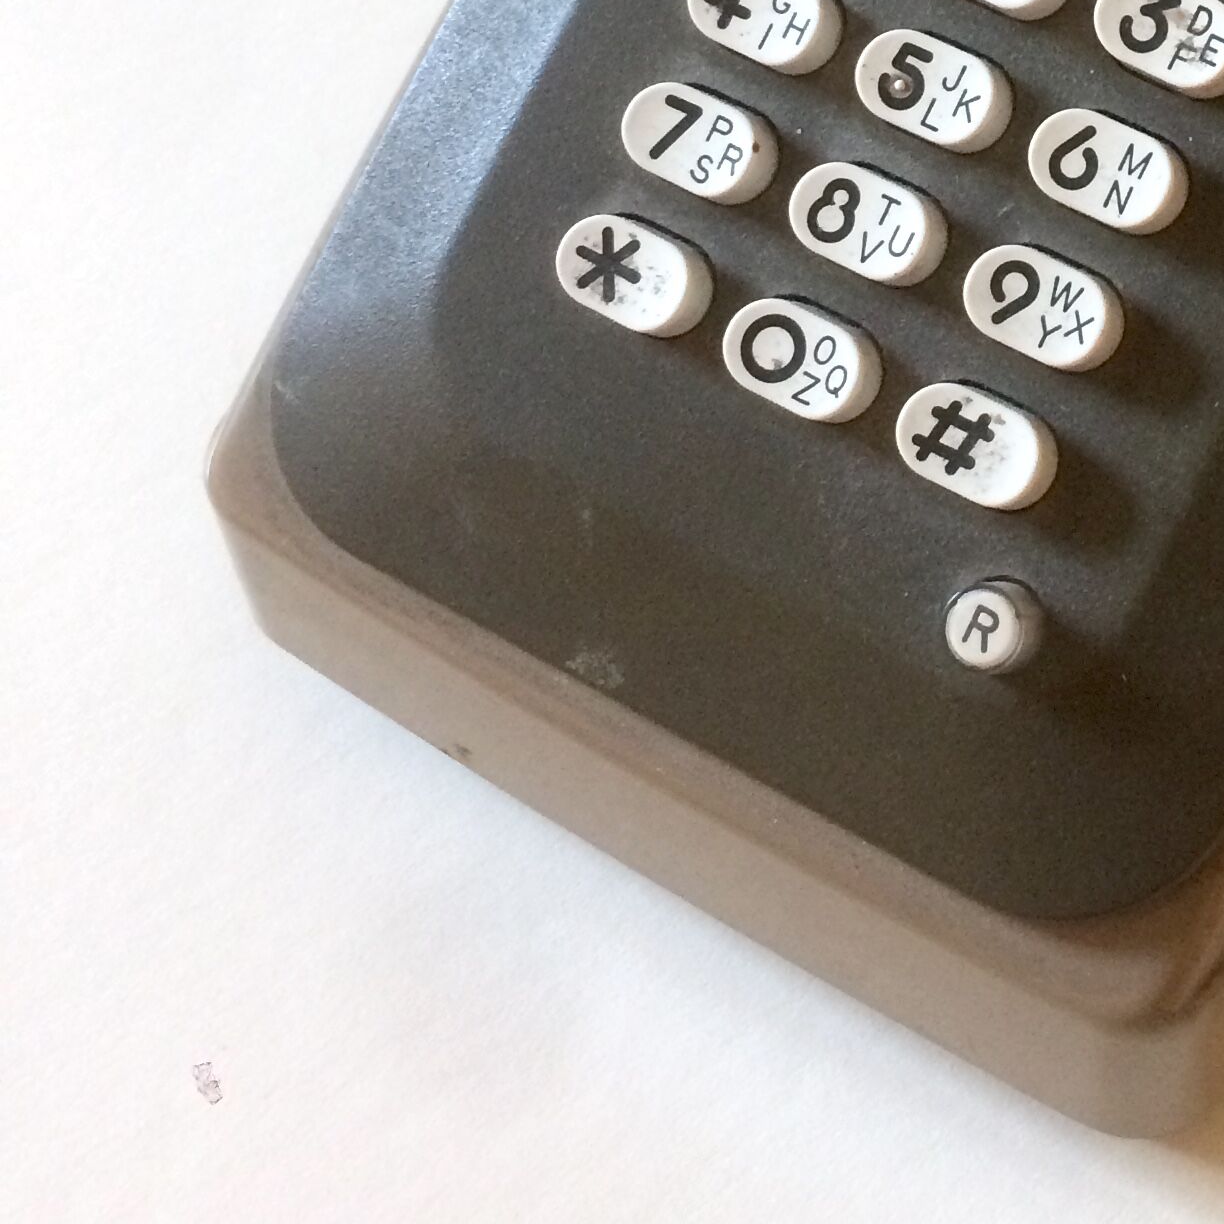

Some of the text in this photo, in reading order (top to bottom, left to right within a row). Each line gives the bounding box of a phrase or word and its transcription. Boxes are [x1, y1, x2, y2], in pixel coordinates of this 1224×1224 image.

[877, 41, 934, 112] 5
[648, 94, 704, 161] 7
[1048, 124, 1099, 191] 6
[806, 177, 862, 244] 8
[989, 258, 1041, 325] 9
[961, 604, 1000, 653] R
